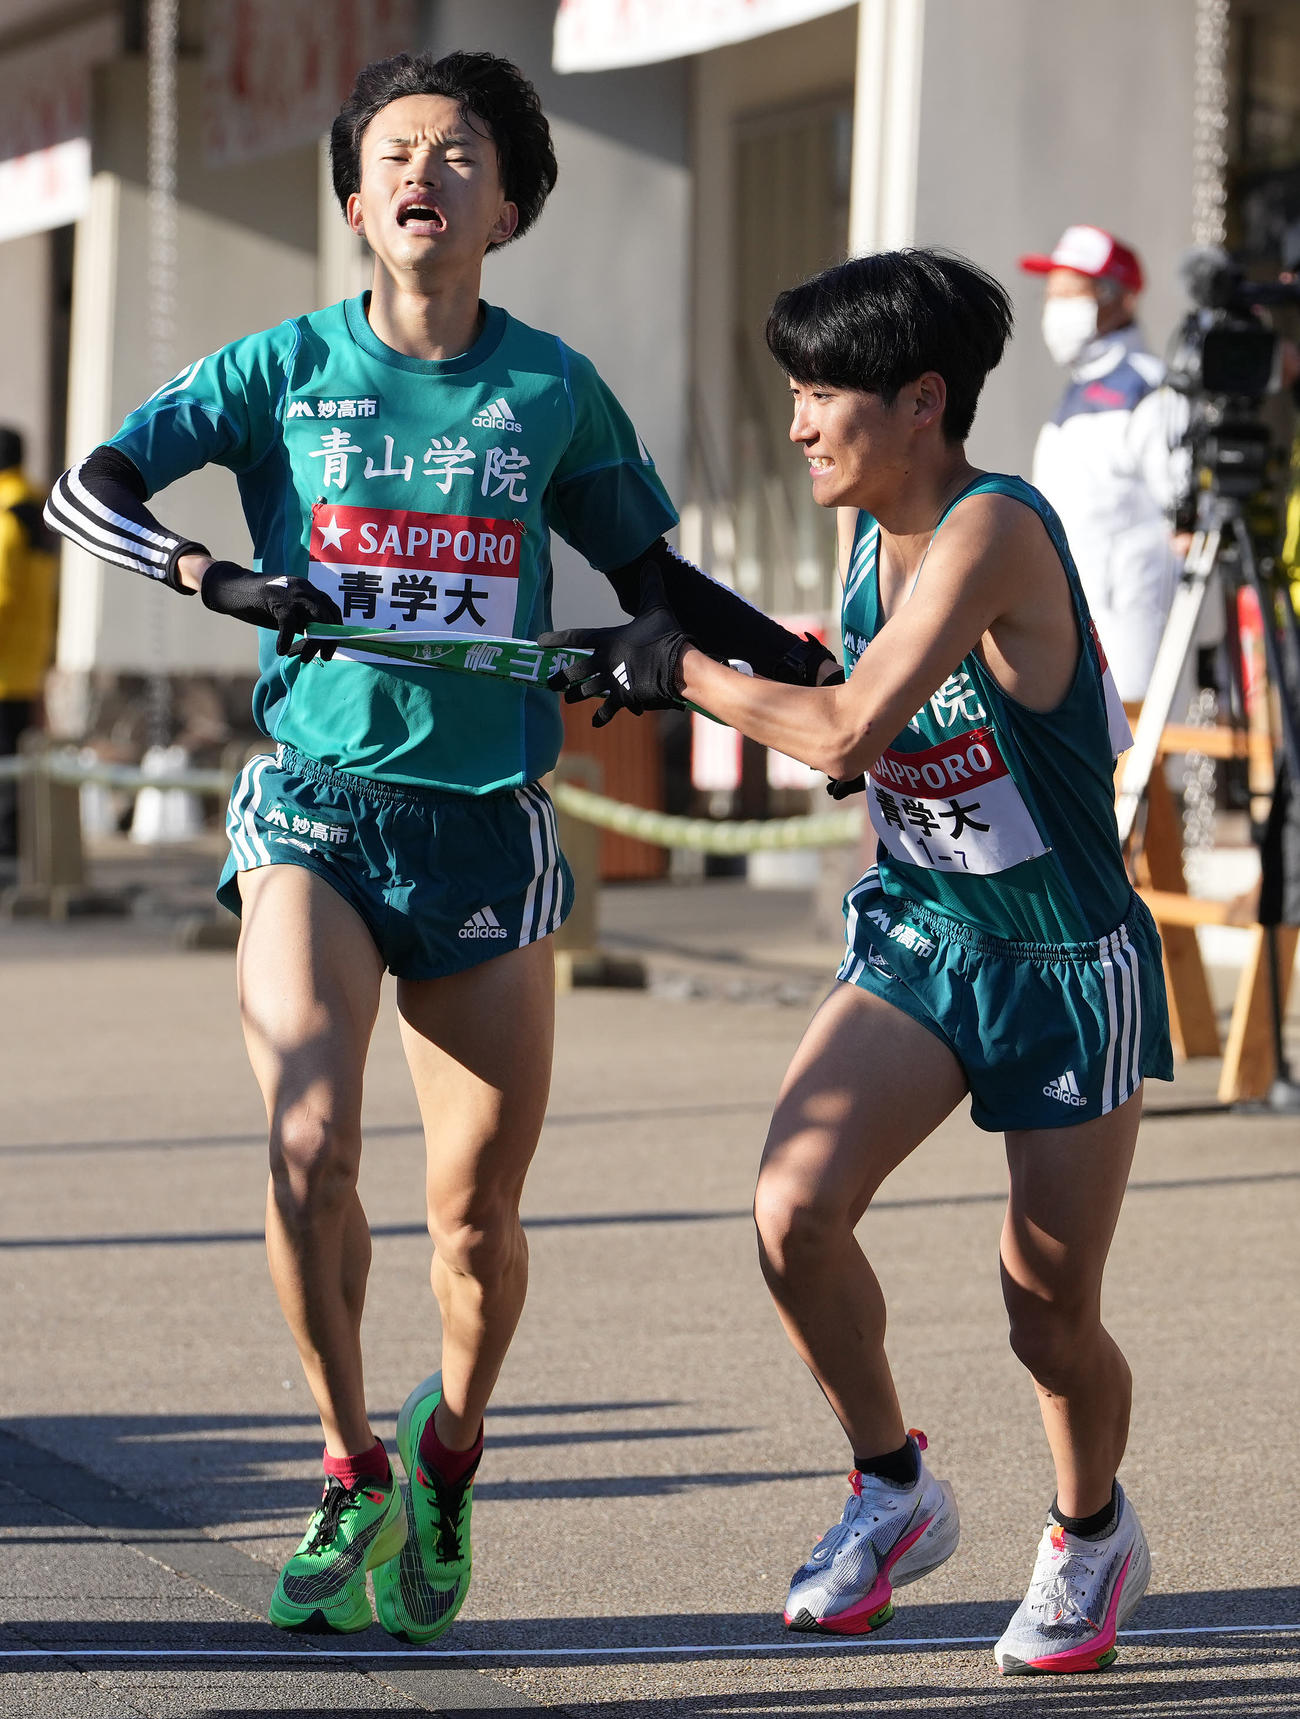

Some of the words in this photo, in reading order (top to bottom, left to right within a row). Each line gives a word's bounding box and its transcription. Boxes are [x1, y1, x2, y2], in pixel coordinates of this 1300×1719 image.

[317, 398, 377, 418] 妙高市
[472, 416, 523, 433] adidas
[308, 427, 532, 503] 青山学院
[358, 522, 516, 565] SAPPORO
[338, 571, 489, 627] 青学大
[873, 785, 990, 840] 青学大
[292, 814, 350, 845] 妙高市
[458, 926, 508, 939] adidas
[1042, 1085, 1088, 1107] adidas
